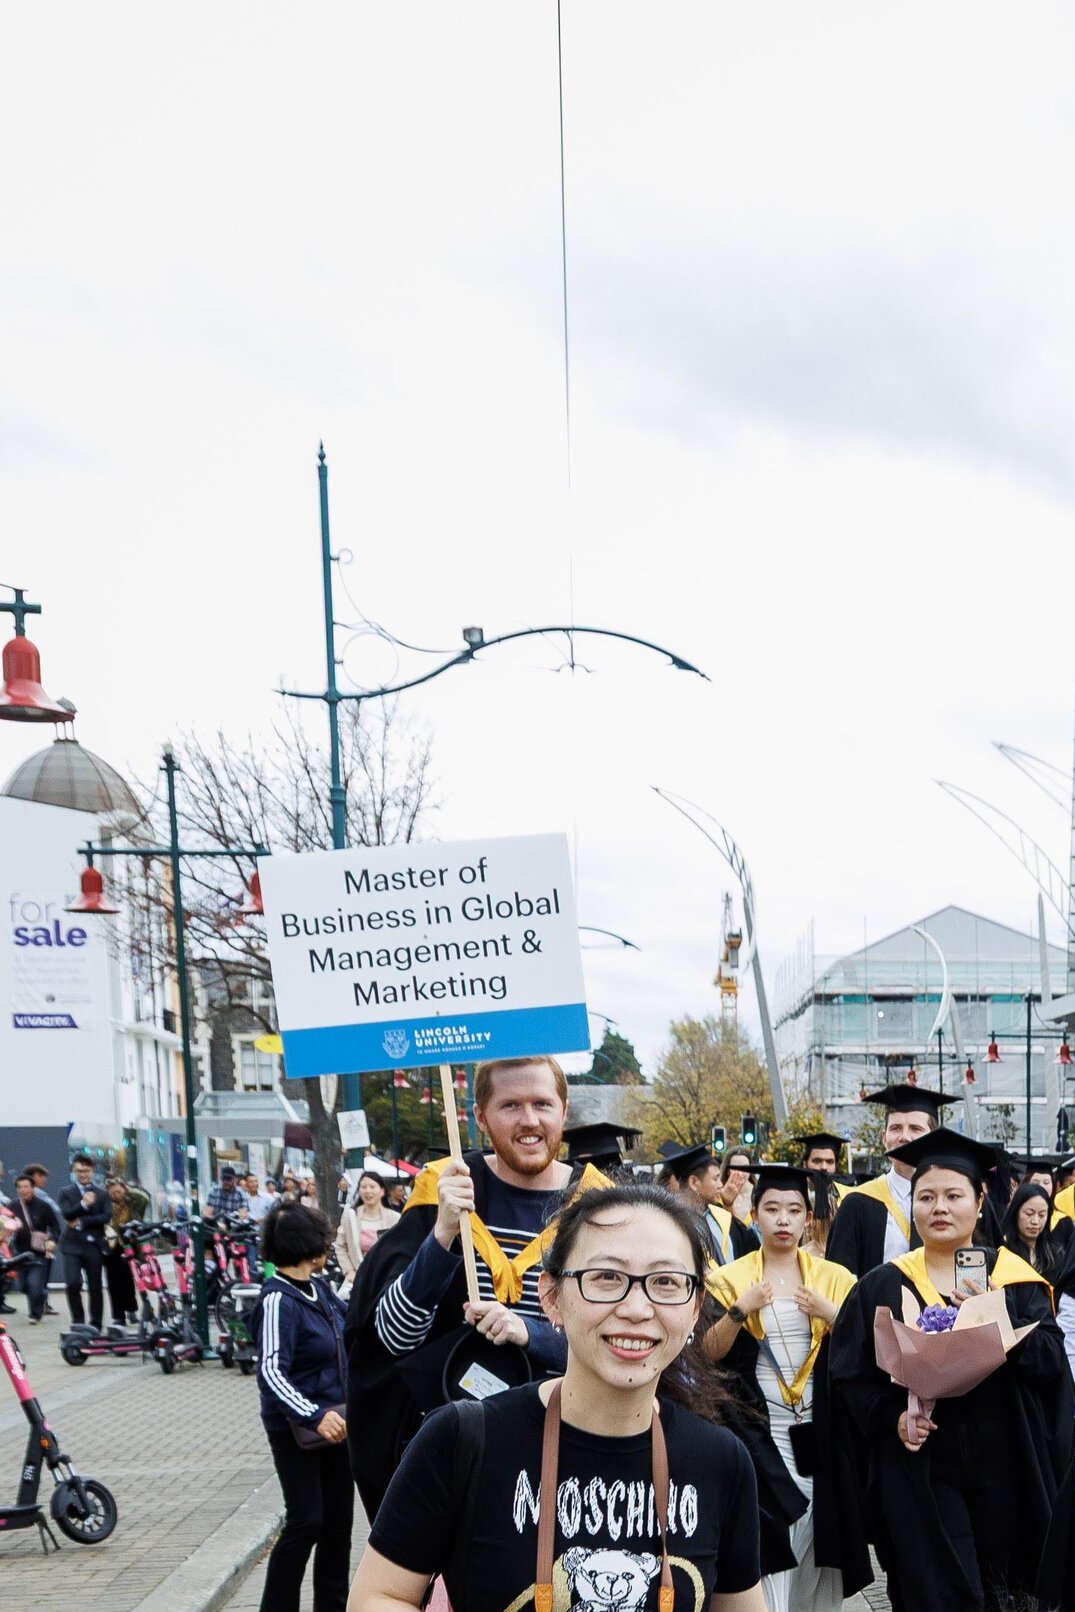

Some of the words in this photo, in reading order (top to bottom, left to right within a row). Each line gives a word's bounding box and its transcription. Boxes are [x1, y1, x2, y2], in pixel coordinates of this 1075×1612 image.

[344, 867, 449, 894] Master
[458, 857, 488, 884] of
[10, 893, 55, 923] for
[281, 908, 417, 938] Business
[425, 900, 452, 925] in
[461, 888, 561, 921] Global
[14, 919, 87, 947] sale
[308, 932, 512, 973] Management
[521, 929, 543, 953] &
[353, 972, 508, 1006] Marketing
[414, 1025, 467, 1039] LINCOLN
[415, 1032, 492, 1048] UNIVERSITY
